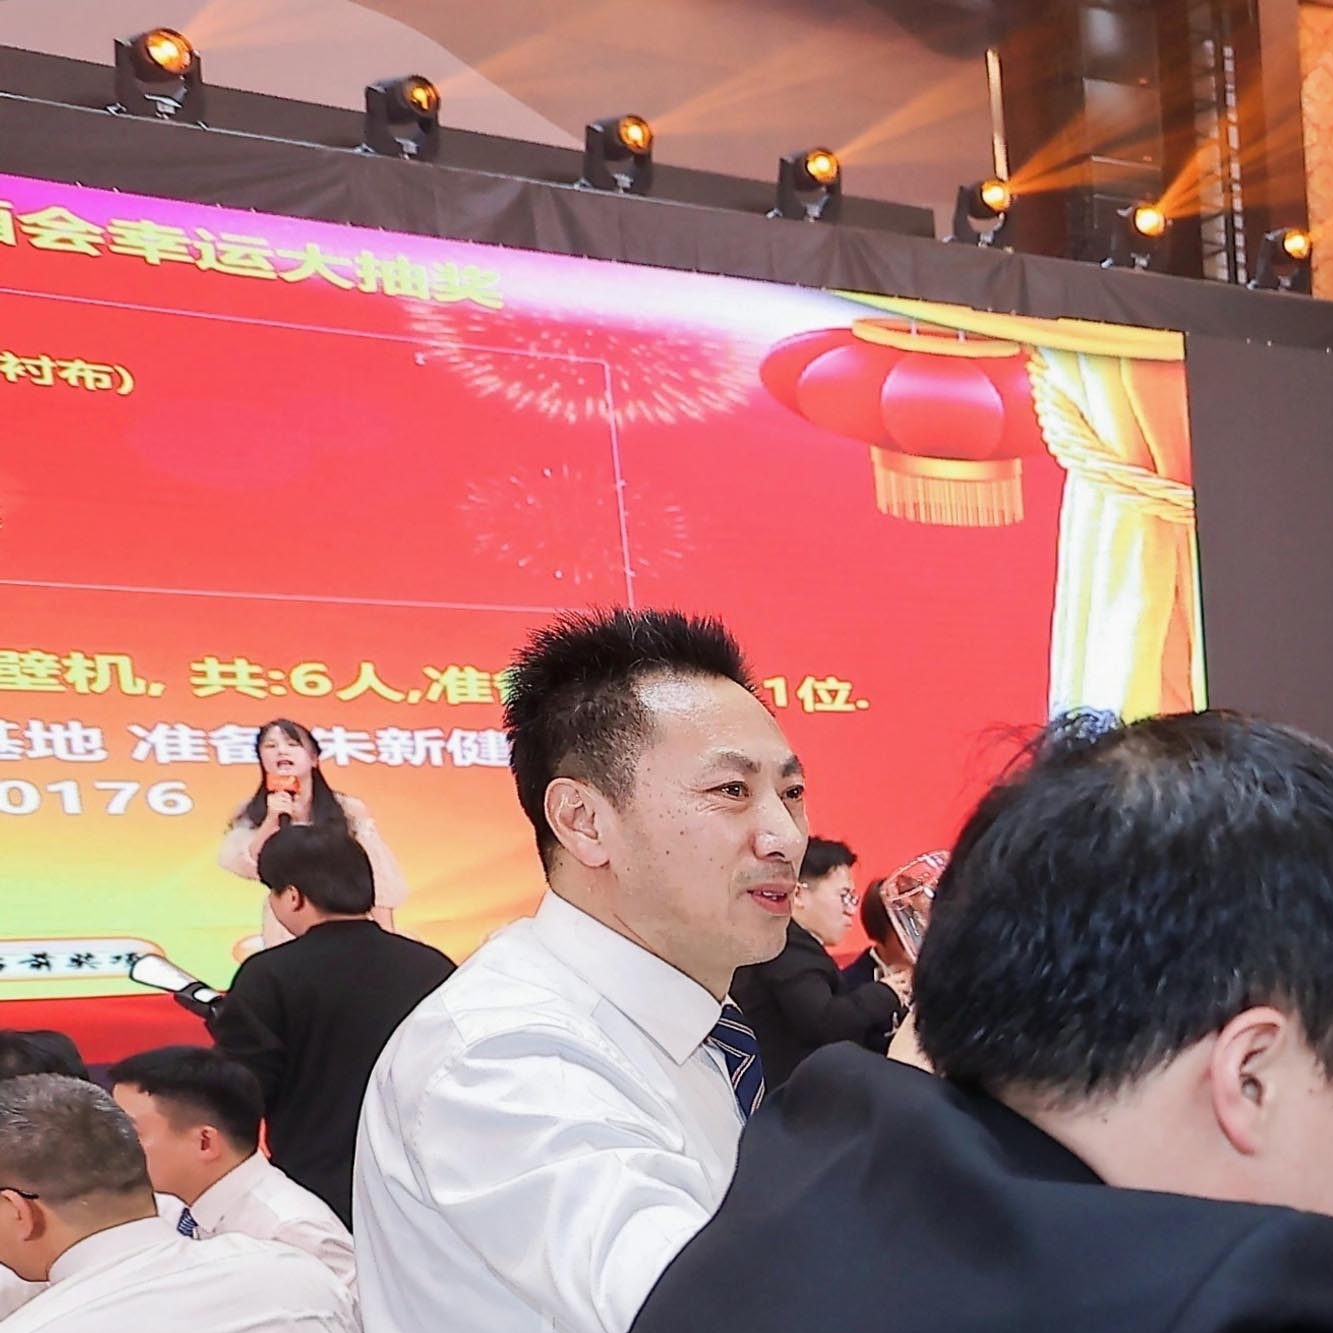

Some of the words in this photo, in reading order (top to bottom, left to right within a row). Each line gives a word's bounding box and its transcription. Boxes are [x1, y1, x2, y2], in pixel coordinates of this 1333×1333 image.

[0, 199, 505, 310] 会幸运大抽奖
[0, 779, 195, 816] 0176
